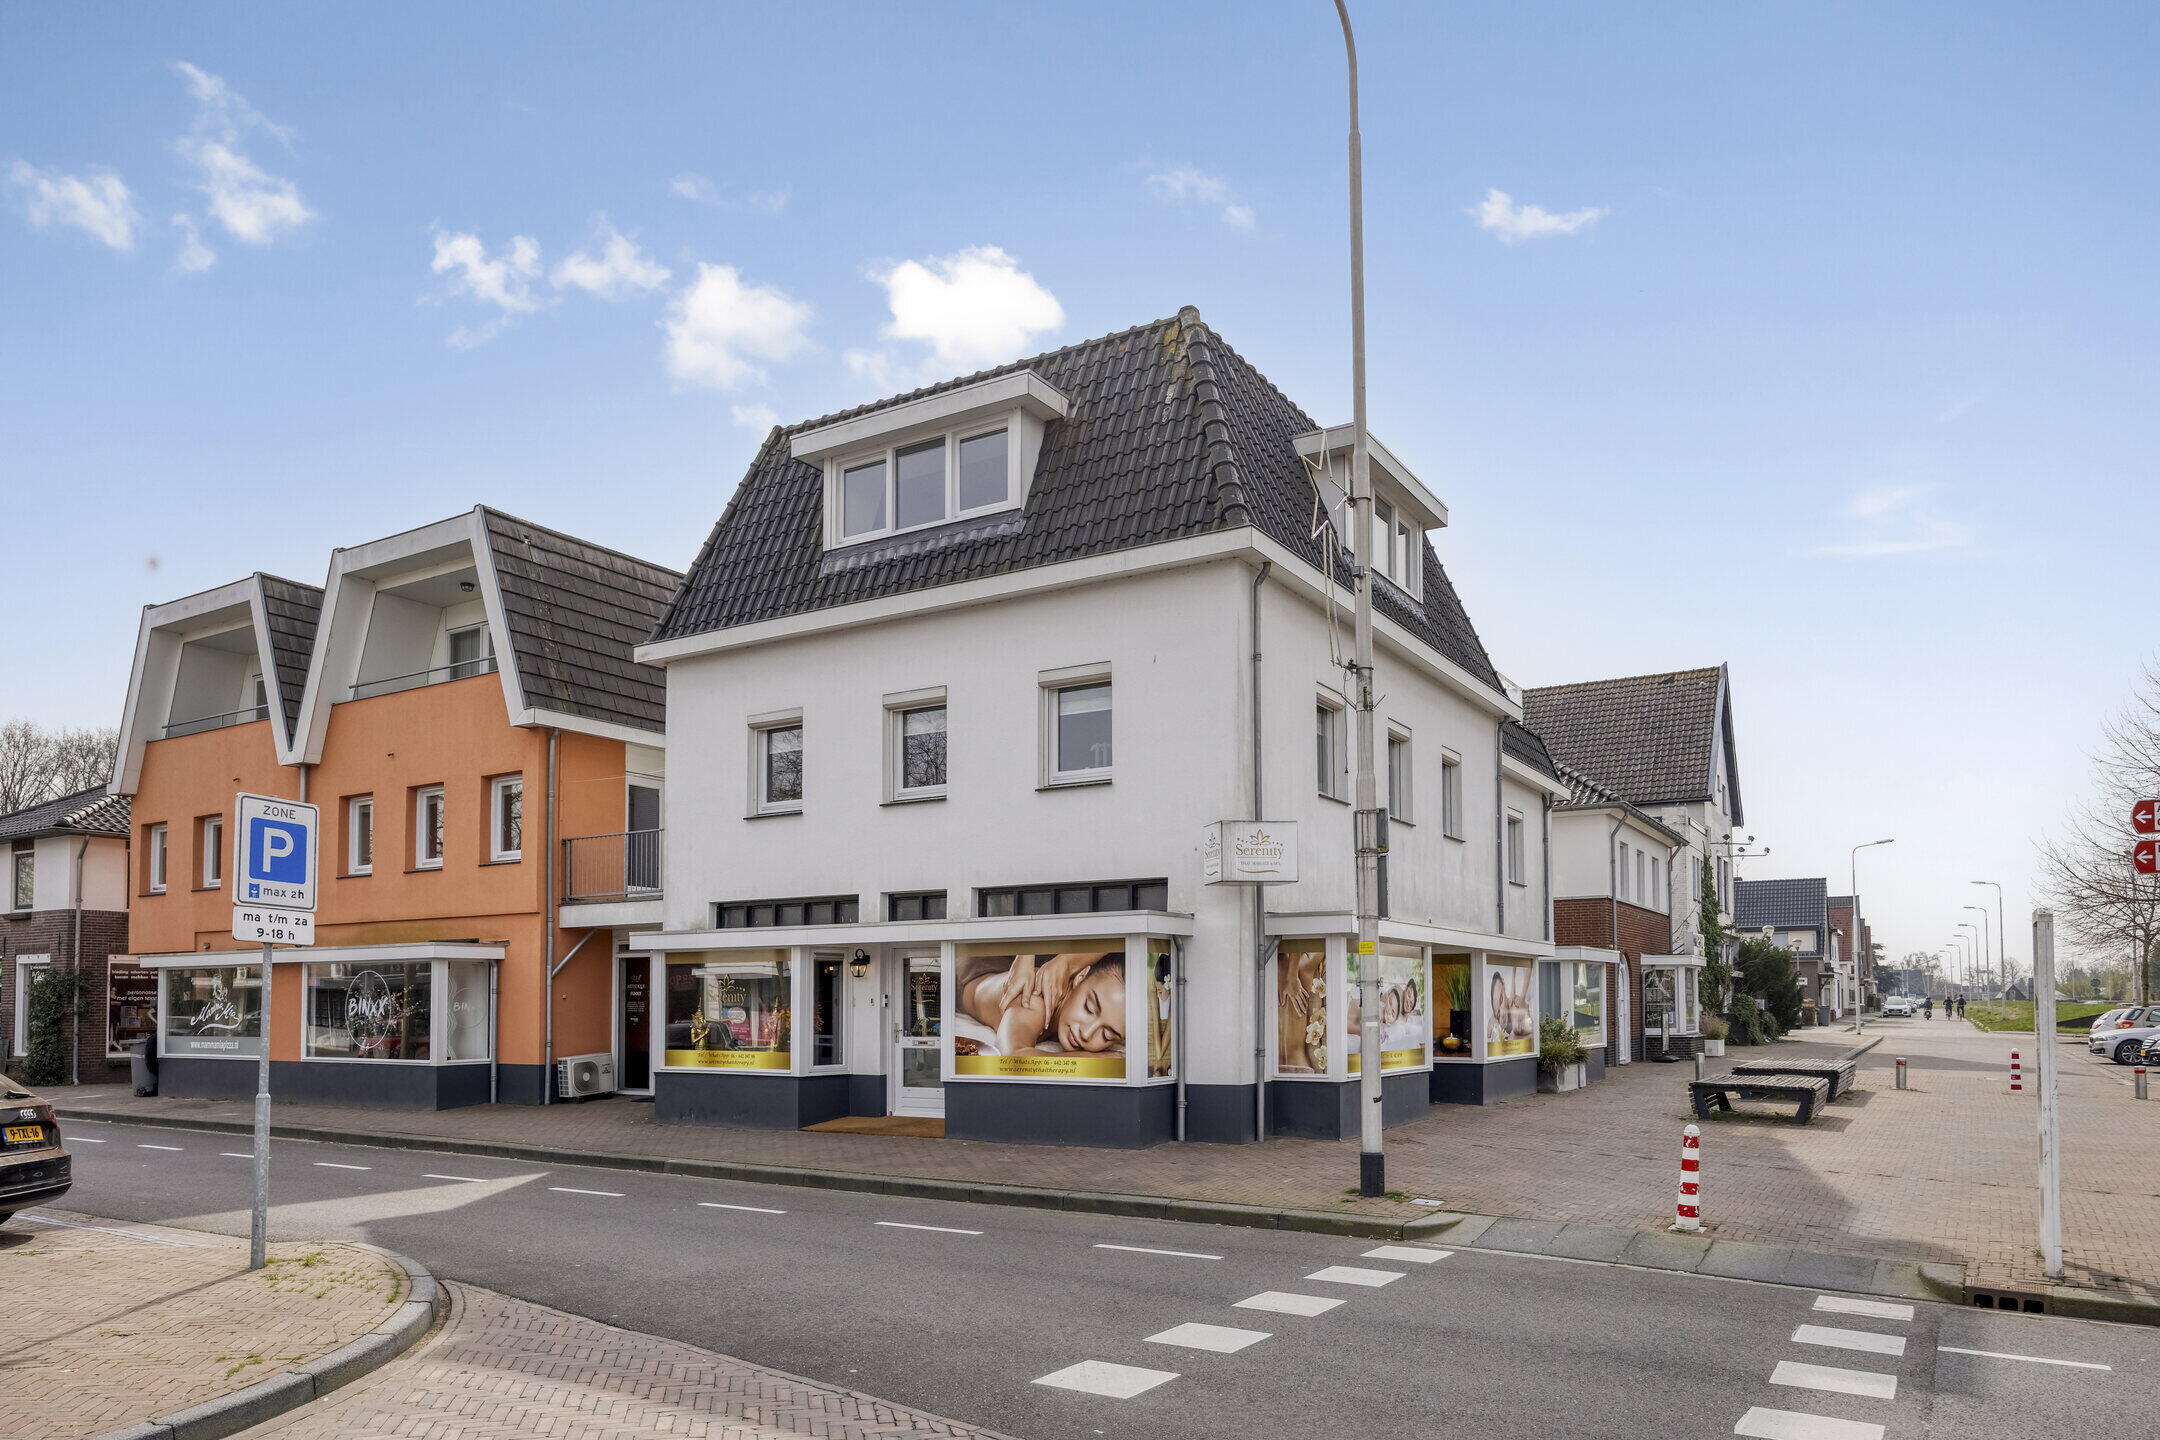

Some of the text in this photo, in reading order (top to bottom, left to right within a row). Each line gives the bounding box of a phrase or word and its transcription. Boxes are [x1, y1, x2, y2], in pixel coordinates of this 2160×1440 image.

[263, 805, 296, 819] ZONE
[262, 826, 294, 873] P
[1235, 843, 1284, 859] Serenity
[263, 887, 305, 899] max 2h
[243, 912, 308, 926] ma t/m za
[256, 928, 295, 940] 9-18 h
[348, 997, 389, 1019] BINXX
[10, 1127, 40, 1140] 9-TXL-16
